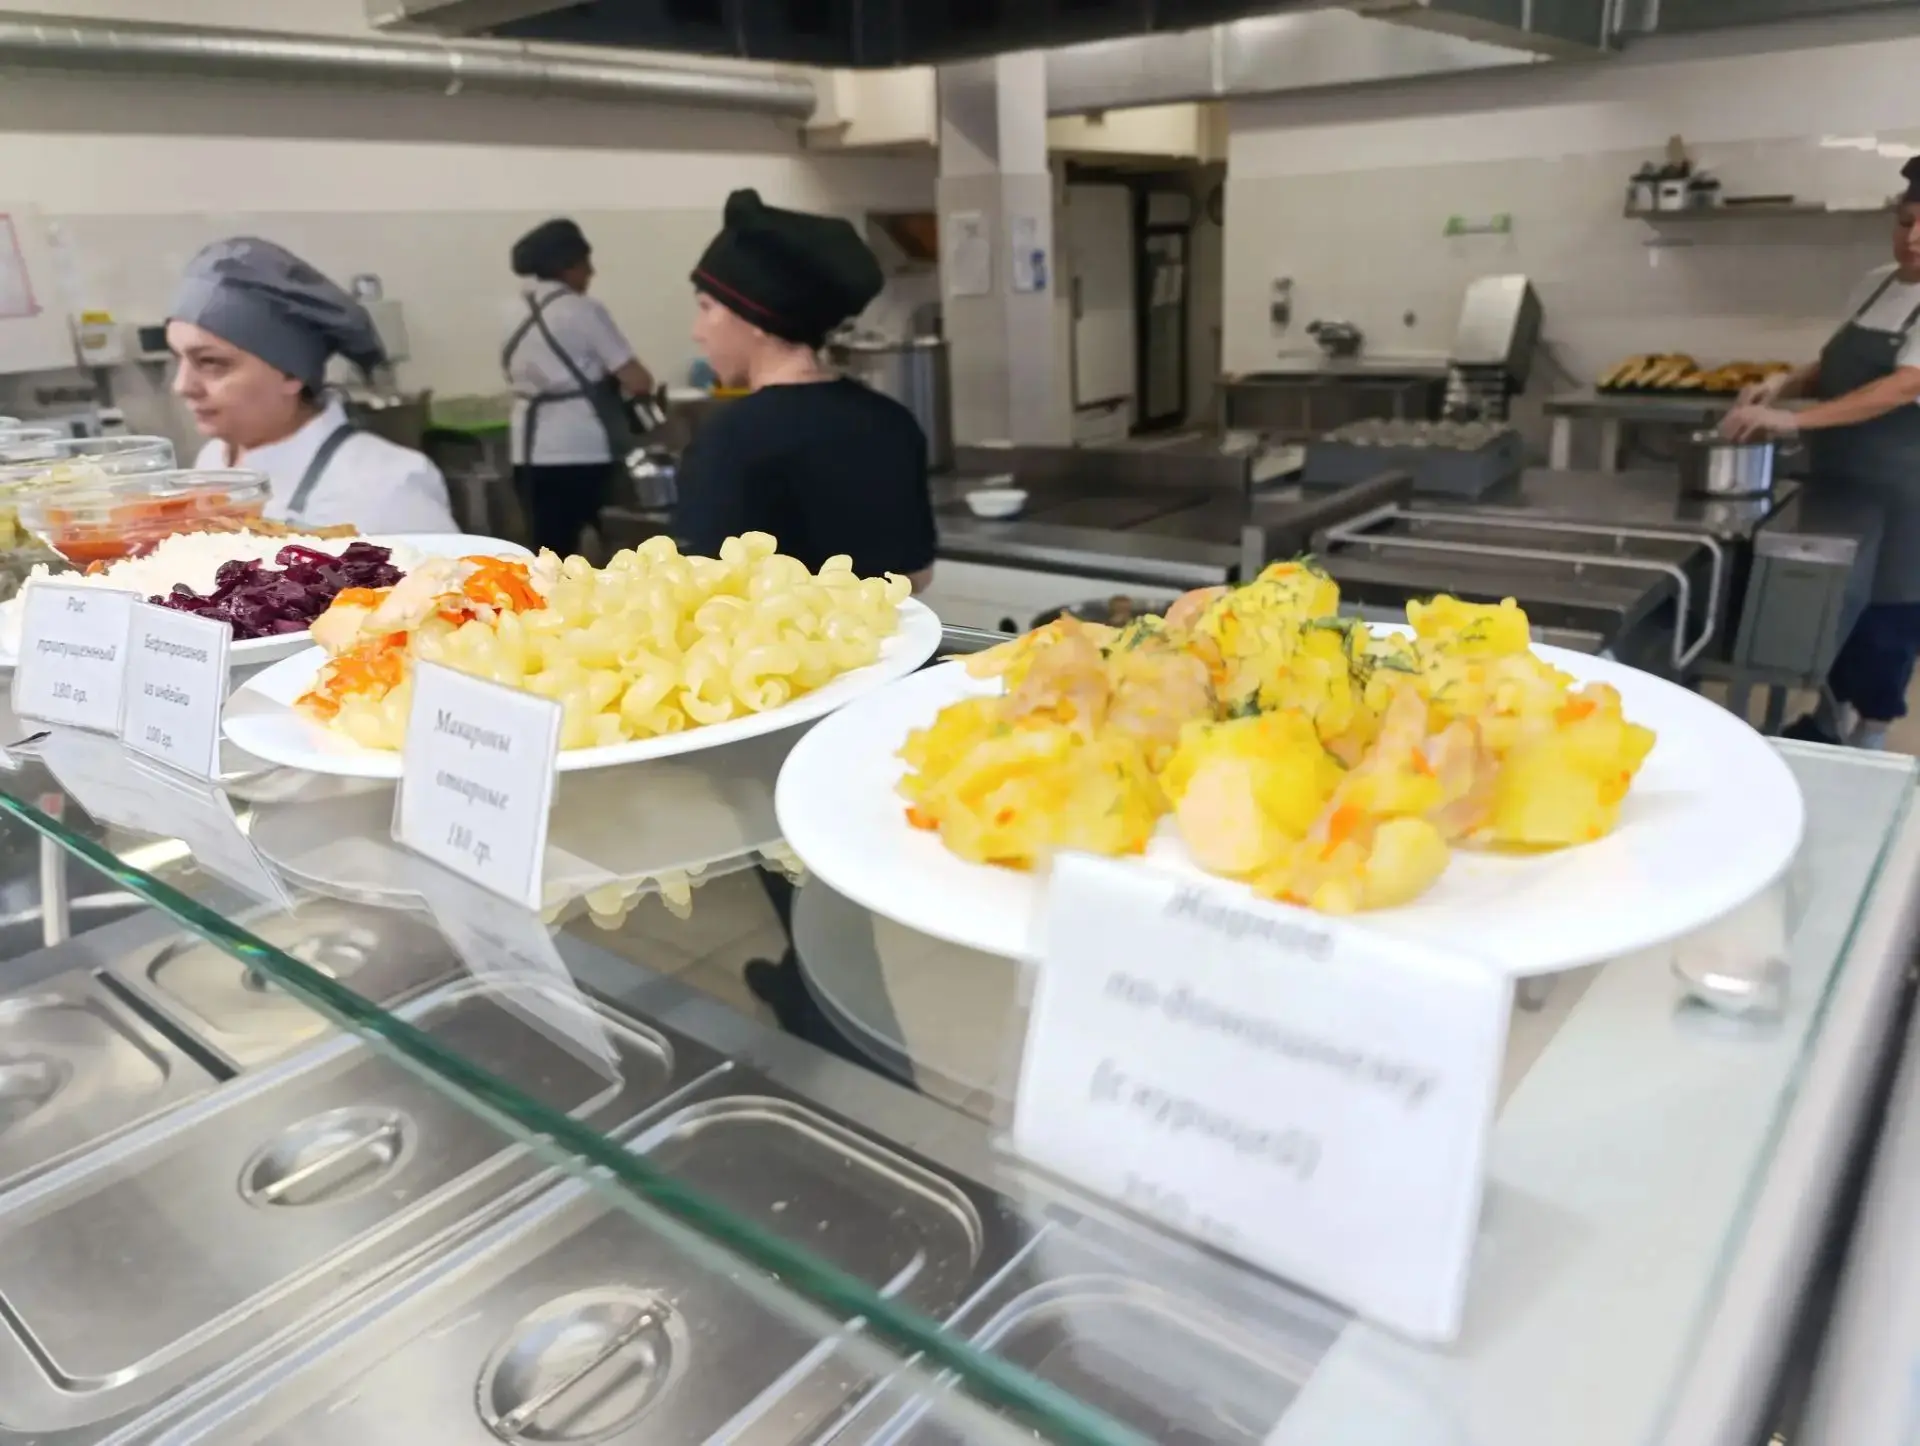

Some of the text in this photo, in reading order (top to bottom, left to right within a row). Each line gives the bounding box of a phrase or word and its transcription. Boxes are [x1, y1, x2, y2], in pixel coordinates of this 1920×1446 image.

[66, 596, 87, 613] Рис
[52, 681, 72, 699] 180
[433, 708, 513, 755] Макароны
[435, 769, 510, 811] отварные
[446, 821, 493, 866] 180 гр.
